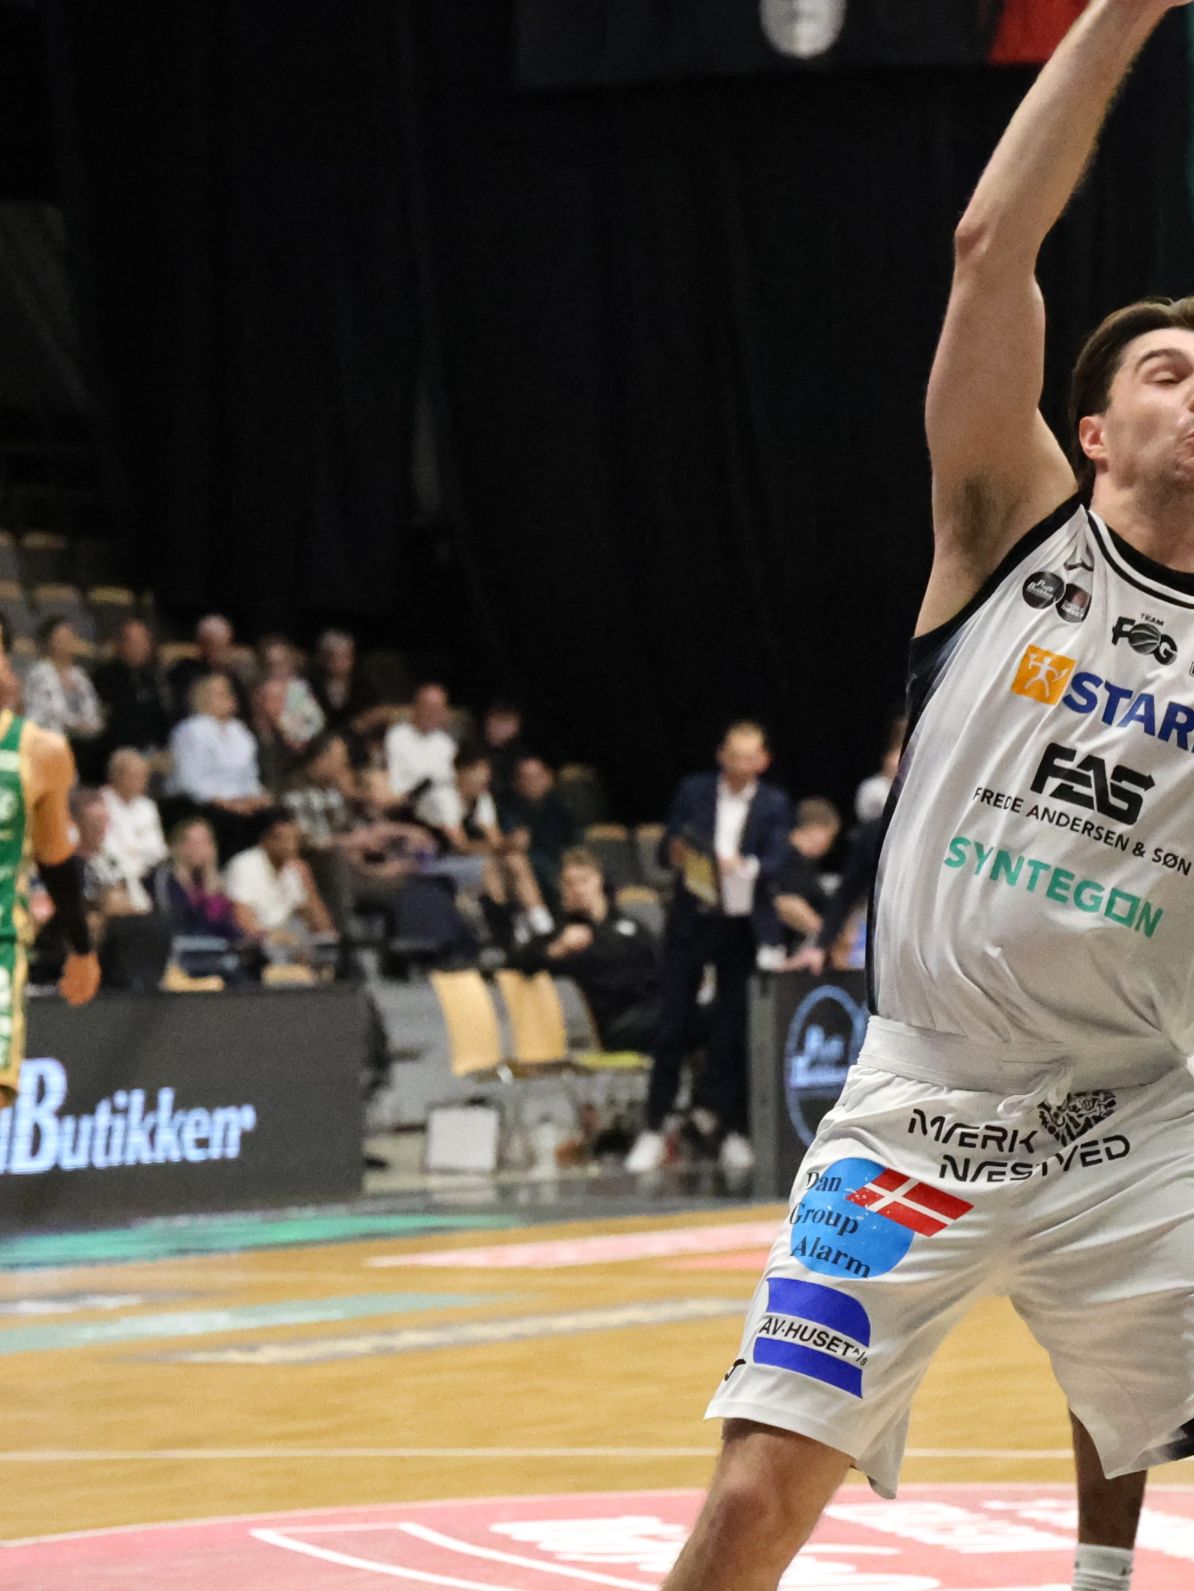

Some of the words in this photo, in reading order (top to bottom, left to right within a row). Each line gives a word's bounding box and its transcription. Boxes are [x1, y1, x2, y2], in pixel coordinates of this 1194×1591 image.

[1140, 612, 1165, 627] TEAM
[1030, 742, 1156, 826] FAS
[974, 786, 1024, 814] FREDE
[1025, 804, 1130, 852] ANDERSEN
[1131, 841, 1147, 858] &
[1151, 847, 1193, 876] SØN
[944, 837, 1165, 938] SYNTEGON
[806, 1171, 843, 1193] Dan
[789, 1202, 859, 1237] Group
[790, 1235, 871, 1279] Alarm
